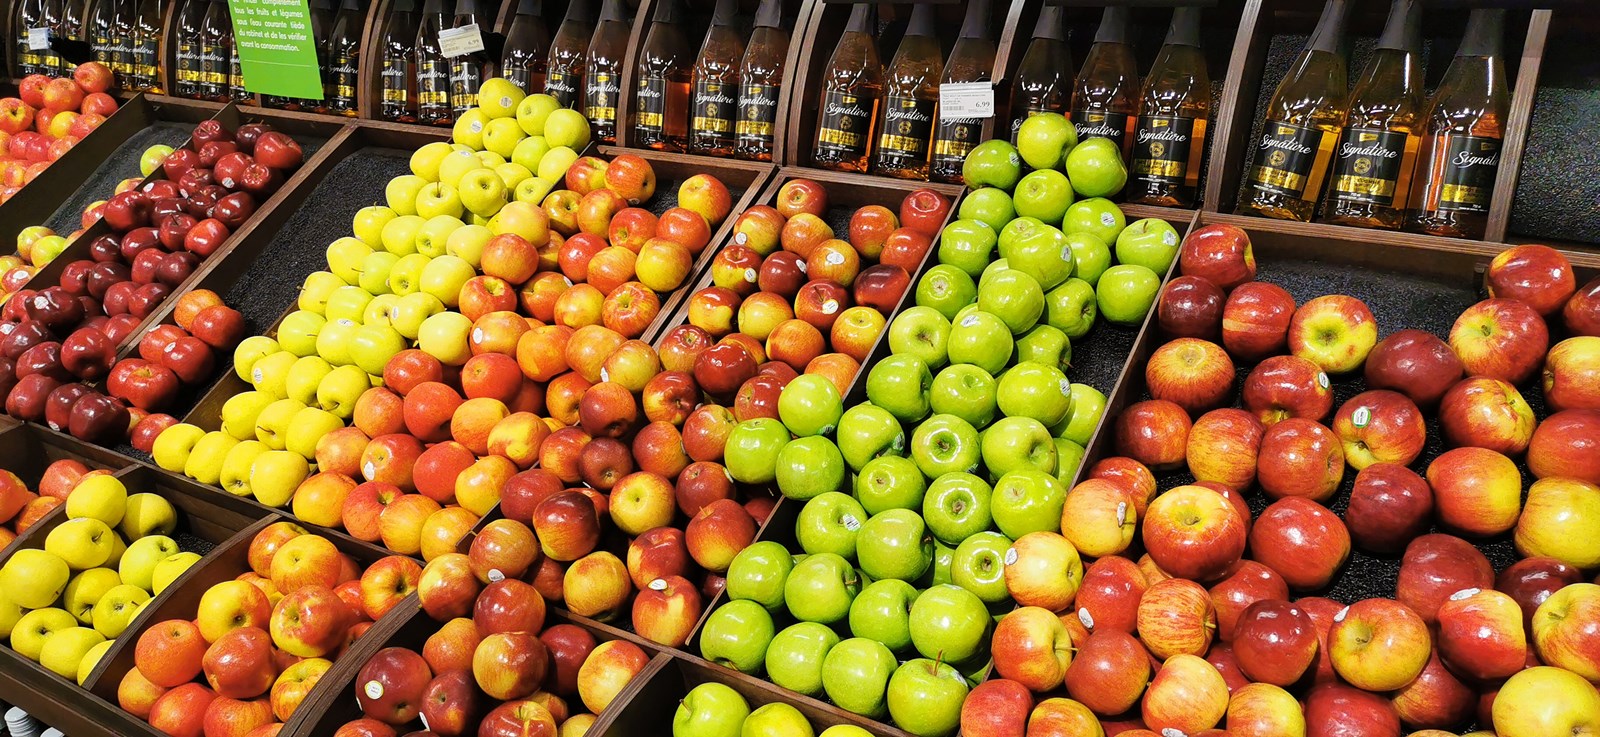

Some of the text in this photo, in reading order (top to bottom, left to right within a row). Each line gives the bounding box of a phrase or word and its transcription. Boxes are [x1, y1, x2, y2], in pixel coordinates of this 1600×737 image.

[256, 8, 269, 16] fruits
[280, 9, 303, 18] légumes
[246, 30, 263, 38] robinet
[261, 43, 300, 52] consommation.
[695, 91, 734, 105] Signature
[738, 94, 777, 108] Signature
[826, 102, 869, 118] Signature
[885, 107, 929, 121] Signature
[1136, 127, 1187, 144] Signature
[1260, 133, 1312, 154] Signature
[1339, 141, 1398, 159] Signature
